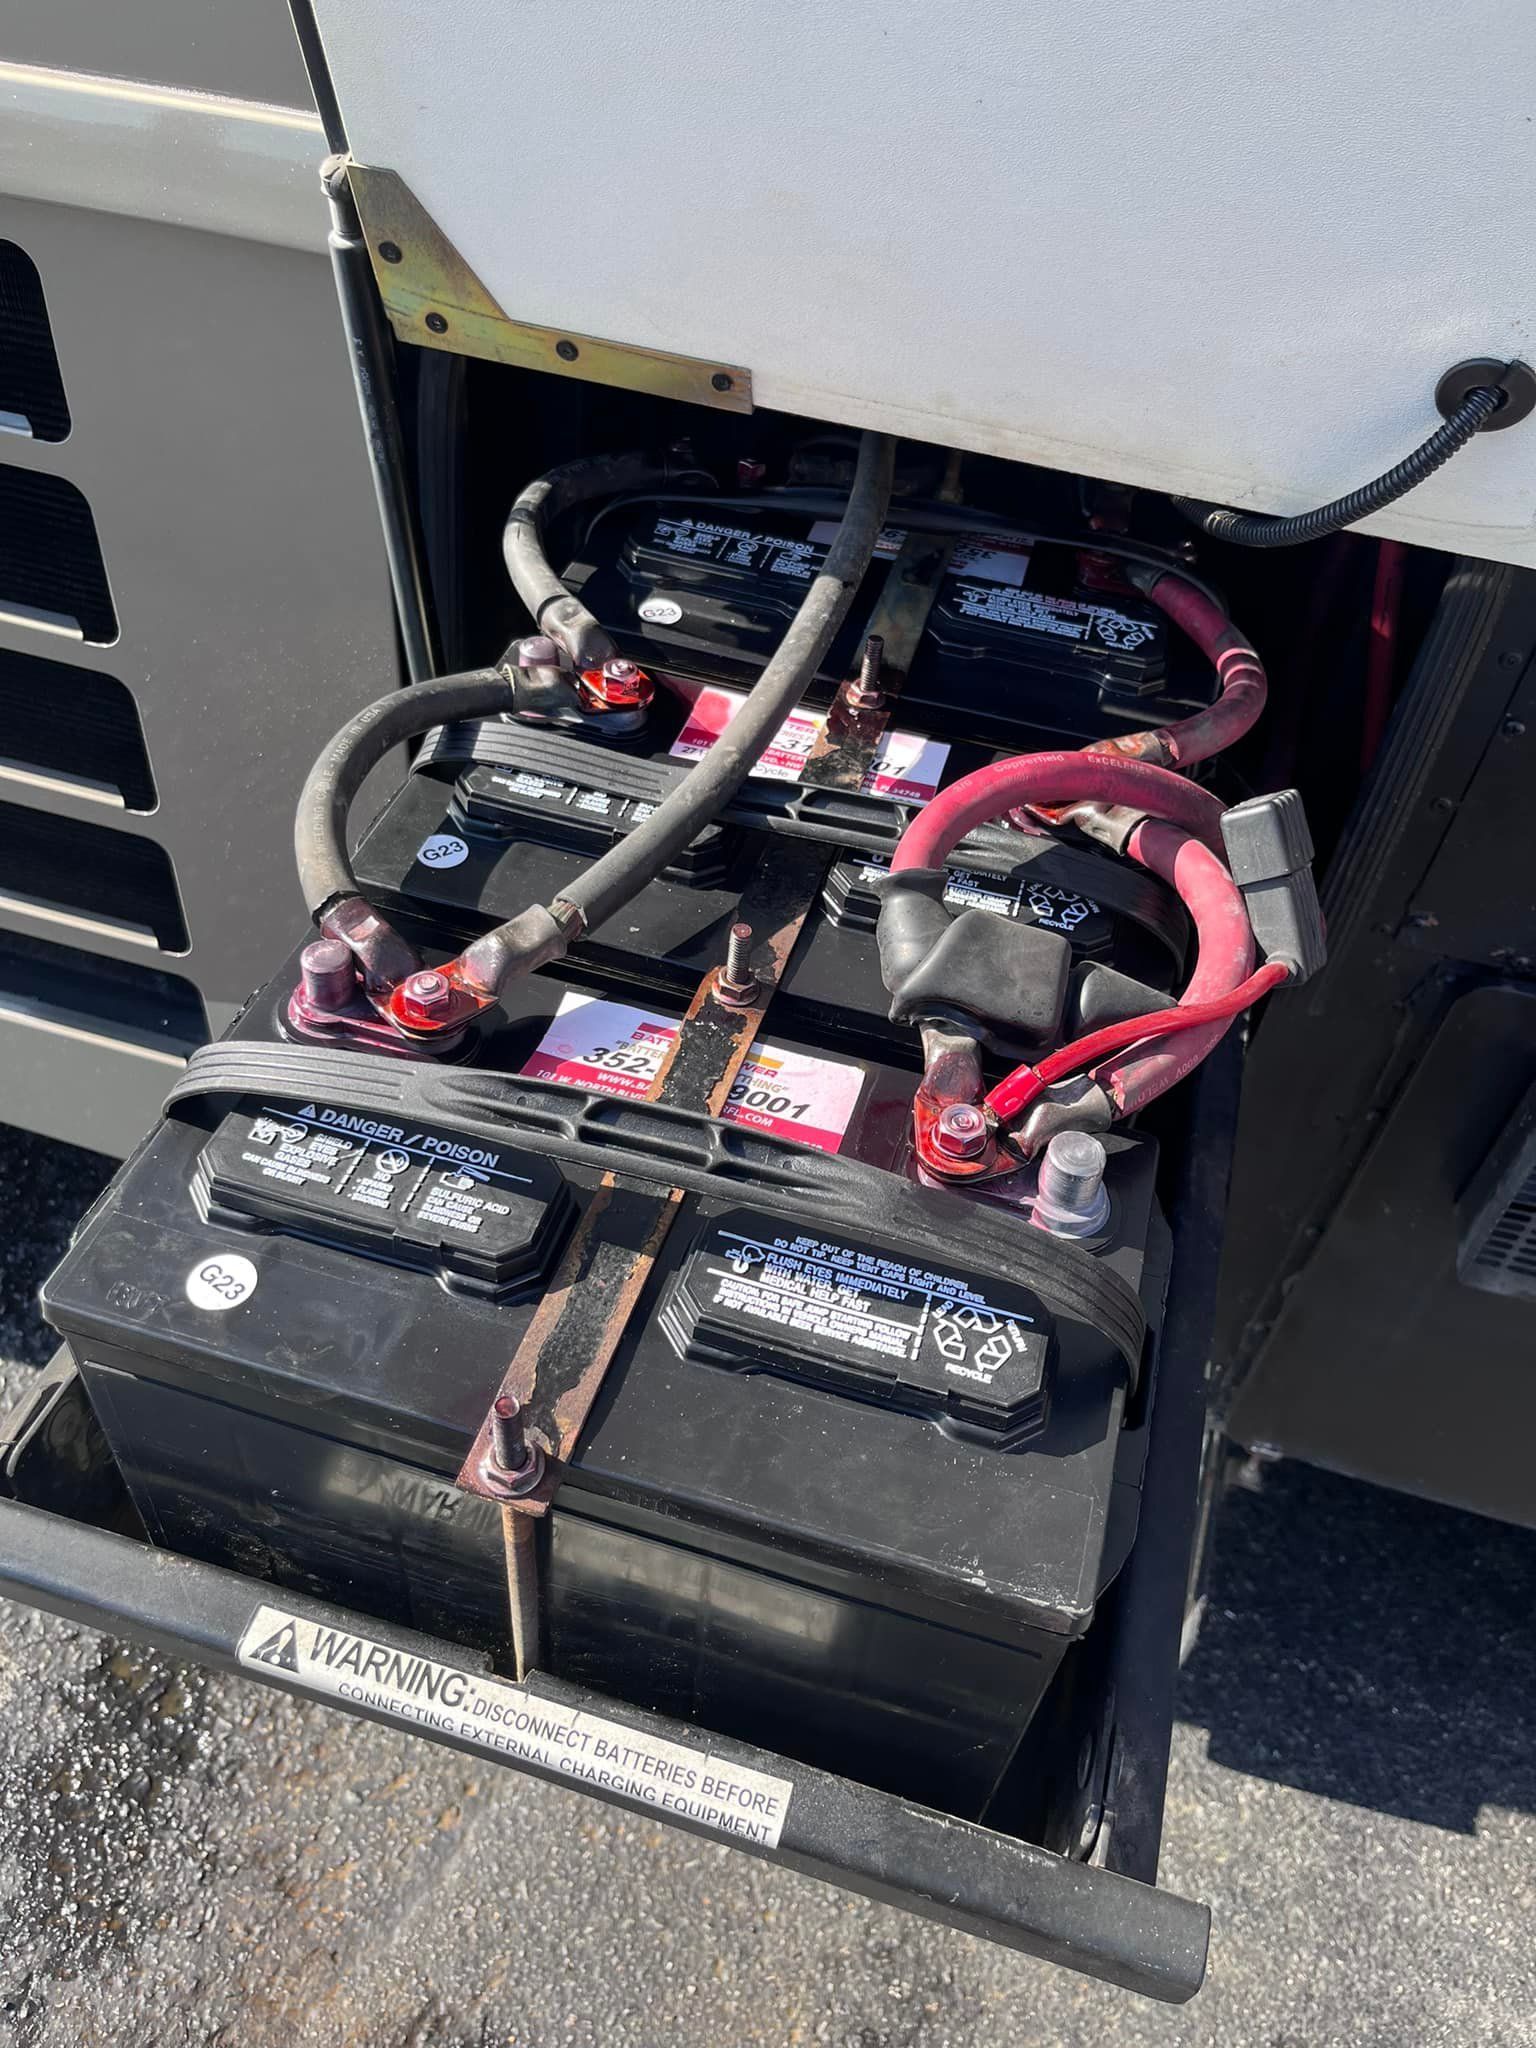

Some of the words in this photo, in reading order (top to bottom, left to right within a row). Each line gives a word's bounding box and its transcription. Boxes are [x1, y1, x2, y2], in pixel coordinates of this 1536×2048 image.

[696, 522, 752, 540] DANGER
[763, 536, 815, 554] POISON
[643, 607, 677, 617] G23
[360, 708, 381, 724] USA
[871, 759, 907, 776] 01
[992, 753, 1066, 773] Copperfield
[423, 841, 464, 861] G23
[1038, 918, 1075, 931] RECYCLE
[630, 1031, 673, 1048] BATT
[739, 1062, 779, 1079] WER
[582, 1047, 657, 1074] 352-
[728, 1084, 811, 1120] 9001
[597, 1071, 652, 1092] WWW.BA
[723, 1103, 774, 1128] FL.COM
[319, 1108, 404, 1144] DANGER
[422, 1136, 500, 1168] POISON
[274, 1151, 312, 1169] GASES
[280, 1142, 339, 1169] EXPLOSIVE
[373, 1171, 391, 1181] NO
[430, 1187, 484, 1208] SULFURIC
[482, 1202, 510, 1215] ACID
[767, 1252, 803, 1271] FLUSH
[804, 1263, 834, 1280] EYES
[835, 1272, 909, 1301] IMMEDIATELY
[774, 1238, 788, 1248] DO
[789, 1243, 810, 1255] NOT
[830, 1255, 855, 1267] KEEP
[857, 1262, 880, 1274] VENT
[881, 1269, 905, 1282] CAPS
[908, 1276, 936, 1290] TIGHT
[936, 1285, 957, 1296] AND
[796, 1236, 820, 1248] KEEP
[821, 1243, 840, 1255] OUT
[842, 1249, 856, 1258] OF
[857, 1253, 876, 1265] THE
[876, 1258, 907, 1274] REACH
[908, 1267, 923, 1277] OF
[923, 1272, 968, 1291] CHILDREN
[199, 1263, 247, 1301] G23
[759, 1271, 808, 1296] MEDICAL
[808, 1288, 840, 1304] HELP
[840, 1297, 871, 1313] FAST
[764, 1262, 793, 1280] WITH
[837, 1283, 862, 1300] GET
[829, 1309, 874, 1331] STARTING
[873, 1322, 912, 1341] FOLLOW
[931, 1300, 955, 1319] LEAD
[944, 1361, 994, 1385] RECYCLE
[309, 1627, 476, 1713] WARNING:
[471, 1699, 592, 1750] DISCONNECT
[593, 1736, 697, 1789] BATTERIES
[700, 1773, 779, 1818] BEFORE
[337, 1681, 455, 1732] CONNECTING
[459, 1722, 553, 1767] EXTERNAL
[559, 1756, 657, 1802] CHARGING
[662, 1789, 773, 1841] EQUIPMENT
